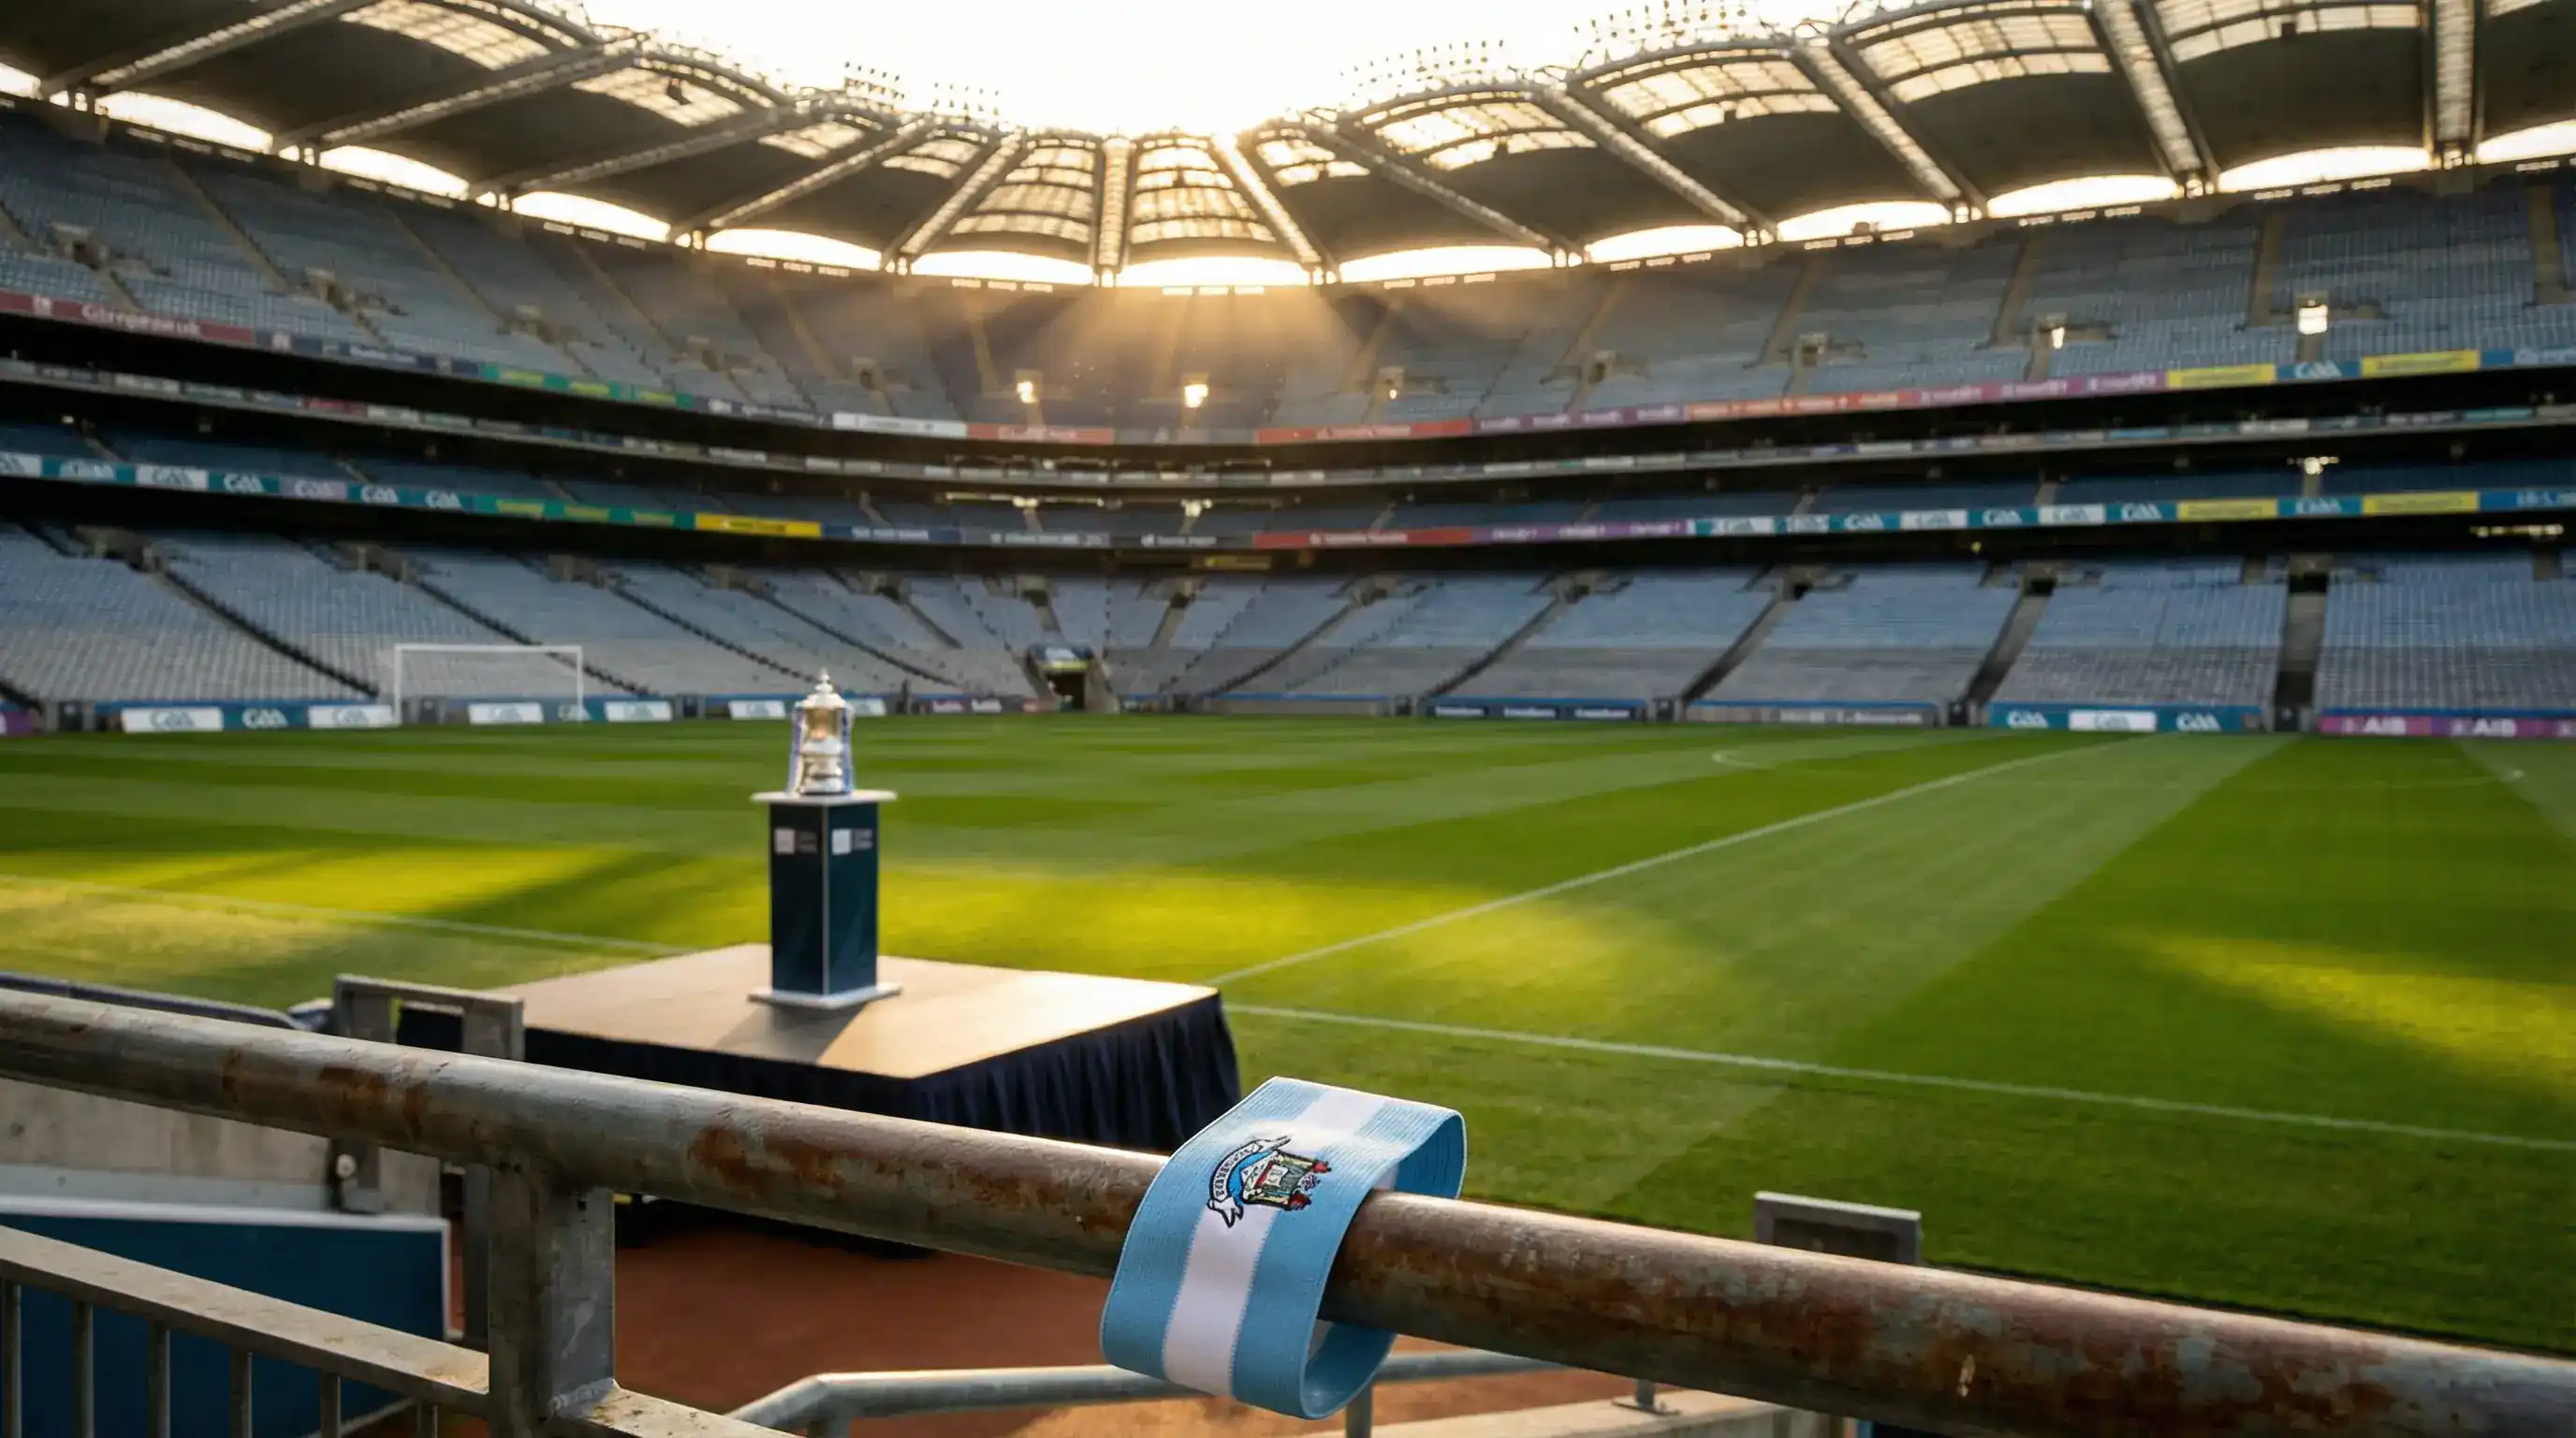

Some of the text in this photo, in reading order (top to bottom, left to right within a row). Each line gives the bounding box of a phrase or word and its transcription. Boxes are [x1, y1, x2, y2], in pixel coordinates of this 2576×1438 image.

[242, 708, 288, 729] GAA
[2006, 711, 2049, 729] GAA
[2175, 712, 2222, 732] GAA
